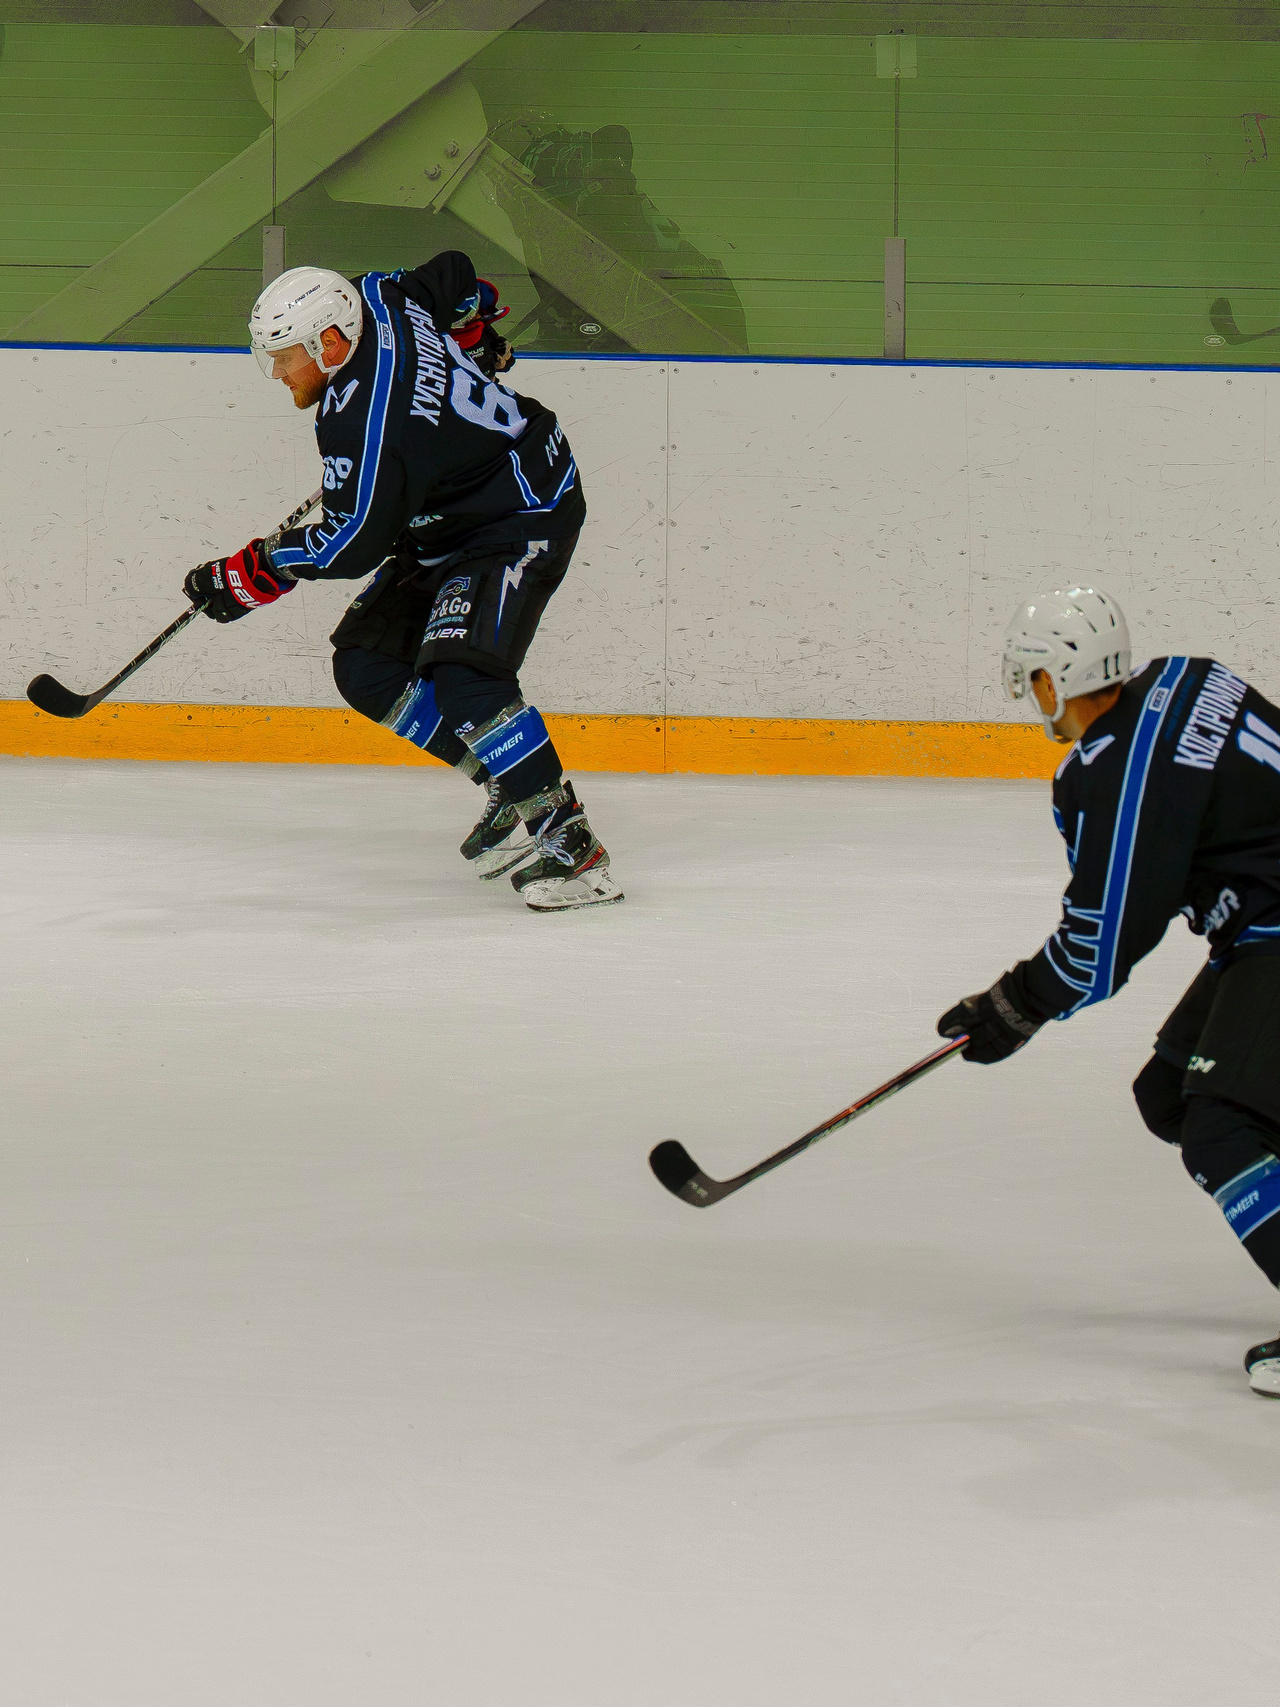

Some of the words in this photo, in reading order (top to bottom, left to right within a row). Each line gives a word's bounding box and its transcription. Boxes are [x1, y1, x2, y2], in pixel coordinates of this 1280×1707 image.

[313, 313, 333, 328] CCM
[324, 456, 353, 490] 69
[215, 561, 224, 590] NEXUS
[1103, 652, 1122, 680] 11
[487, 731, 524, 760] TIMER
